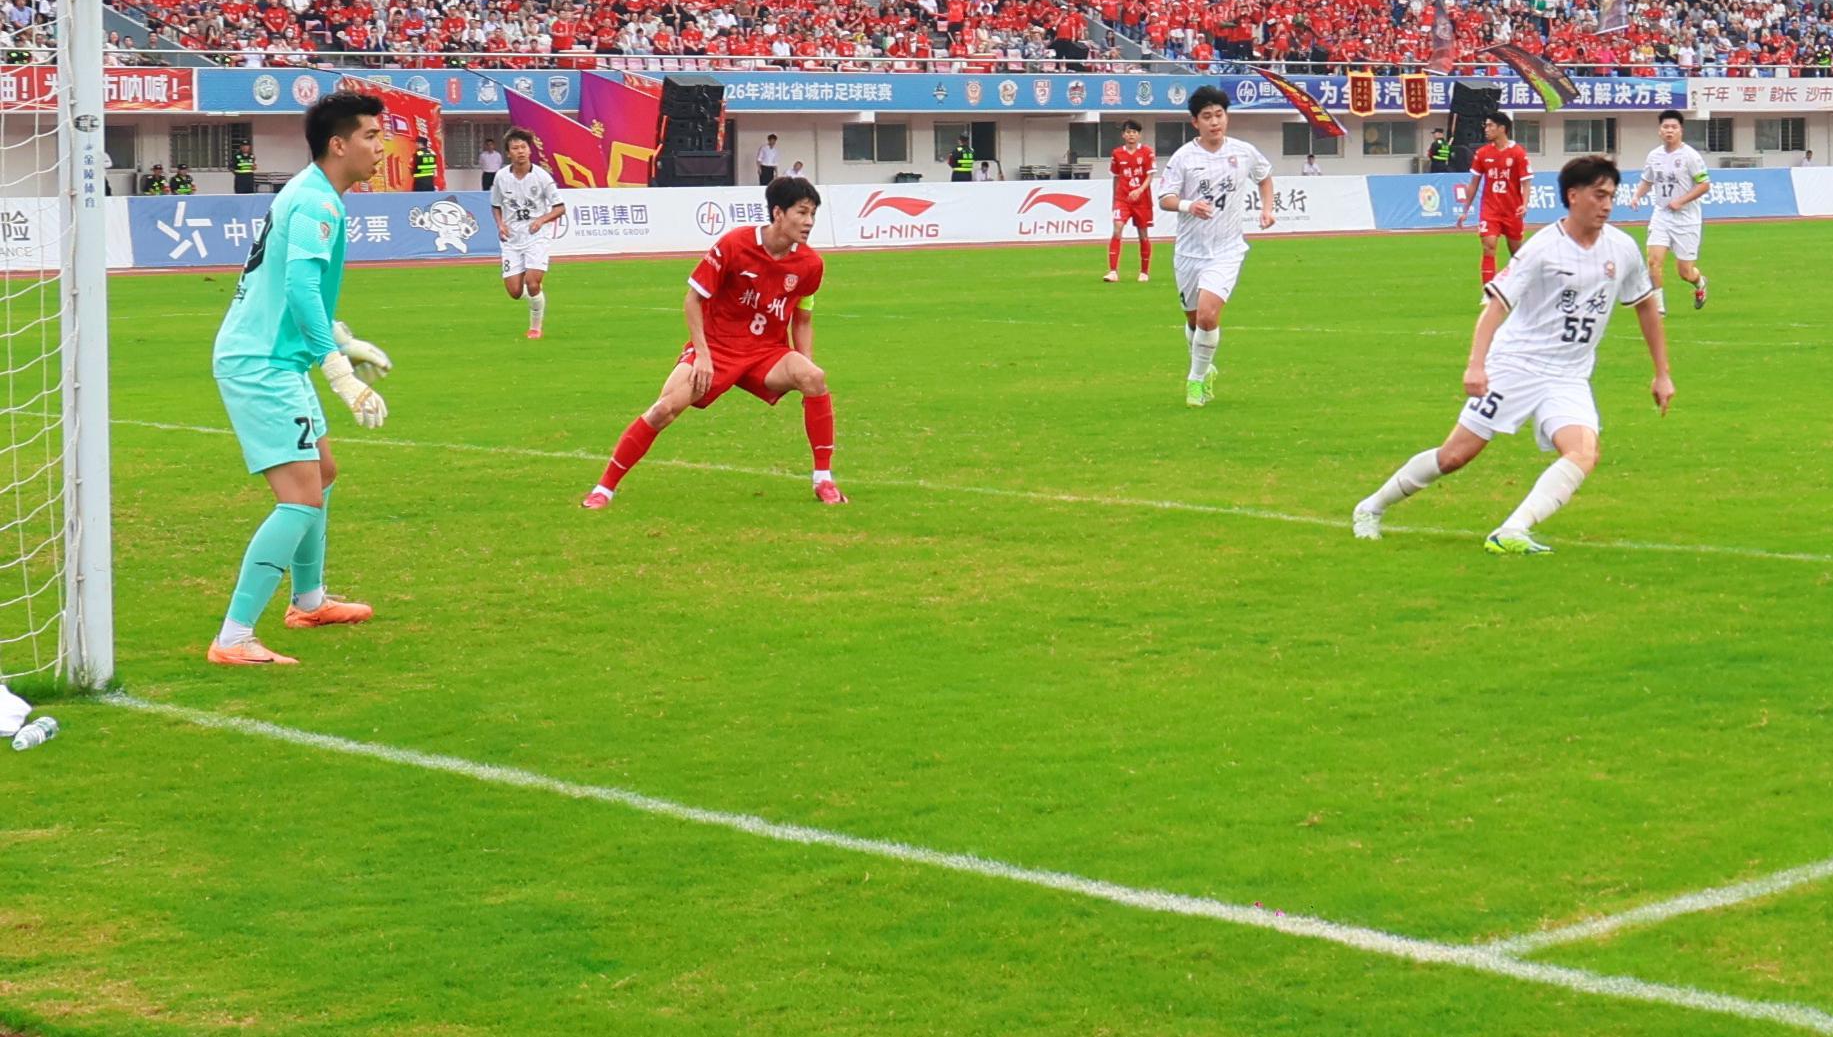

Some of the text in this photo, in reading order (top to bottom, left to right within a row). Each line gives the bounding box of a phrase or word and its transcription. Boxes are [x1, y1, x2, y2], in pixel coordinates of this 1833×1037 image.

[1491, 180, 1508, 194] 62
[1662, 184, 1675, 197] 17
[573, 204, 649, 226] 恒隆集团
[728, 203, 771, 223] 恒隆
[224, 214, 392, 248] 中国彩票
[623, 227, 650, 236] GROUP
[860, 223, 940, 240] LI-NING
[1018, 219, 1094, 236] LI-NING
[750, 313, 768, 336] 8
[1560, 316, 1596, 344] 55
